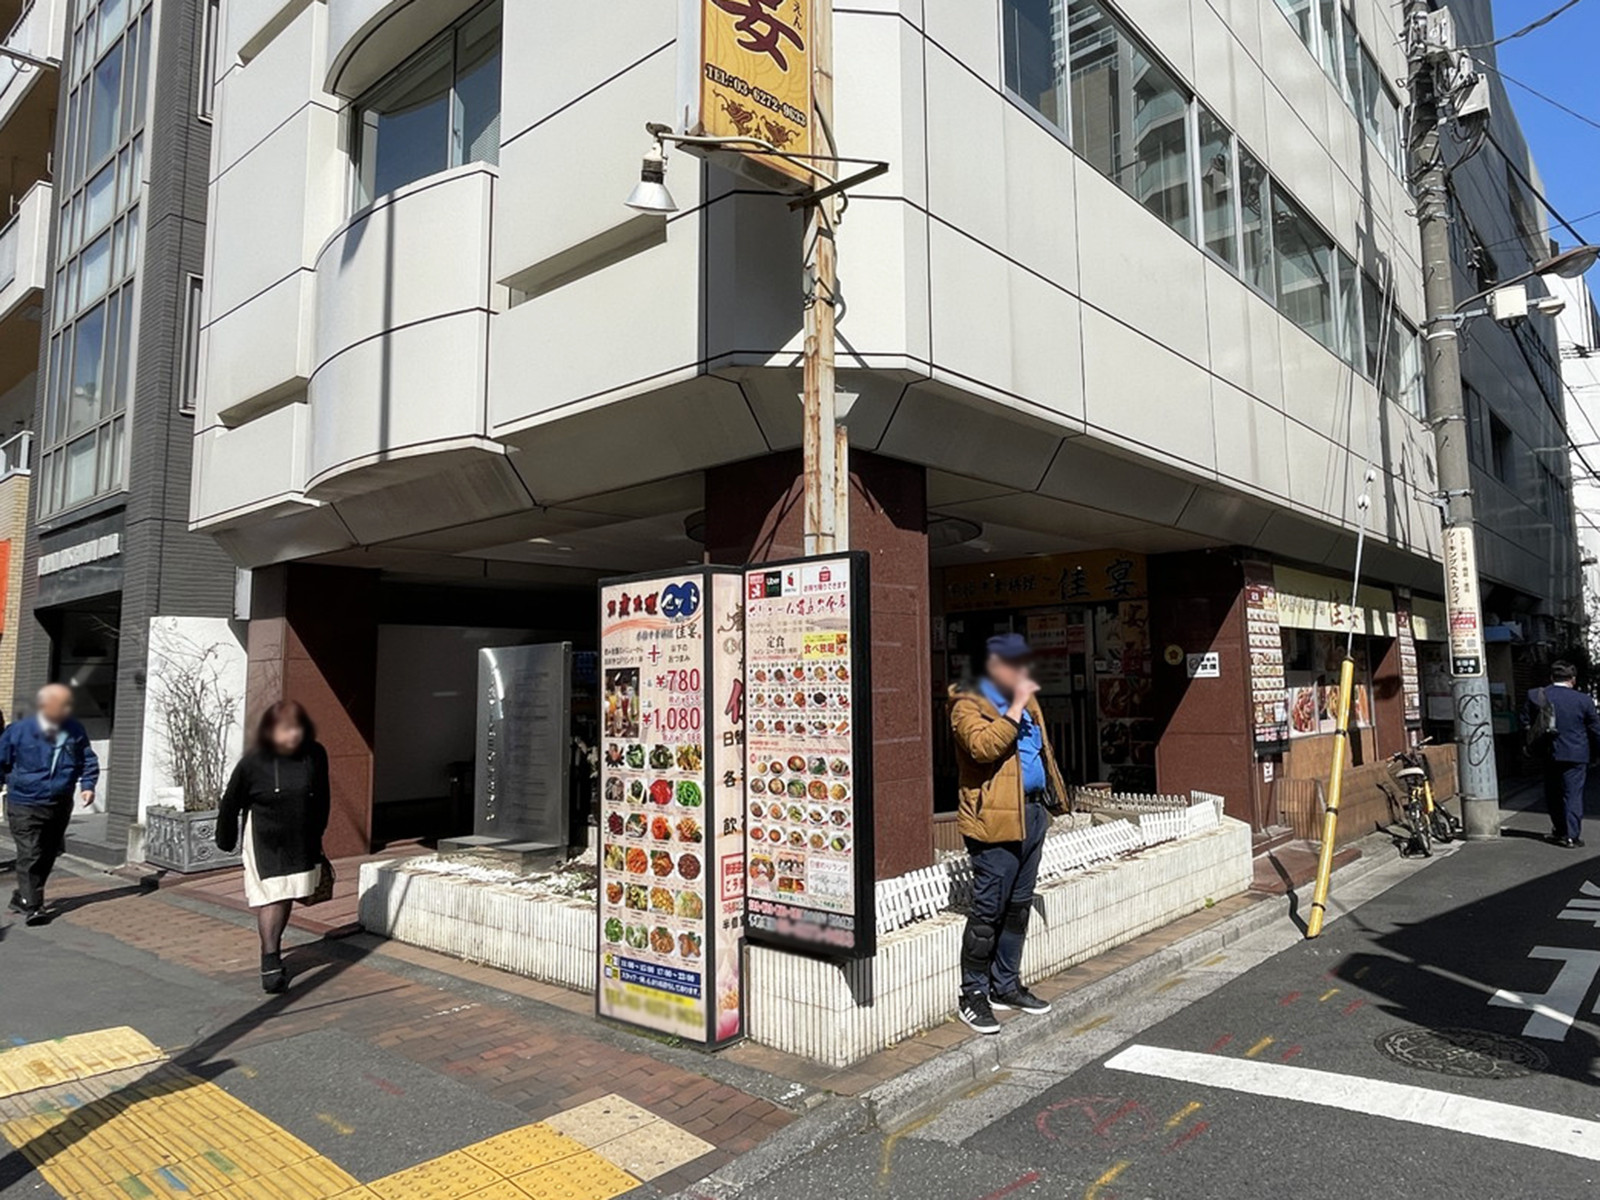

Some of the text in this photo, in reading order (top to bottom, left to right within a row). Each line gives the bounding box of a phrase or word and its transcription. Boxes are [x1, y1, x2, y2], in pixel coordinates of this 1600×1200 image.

[1058, 557, 1136, 600] 佳宴
[656, 669, 700, 691] ¥780
[643, 707, 700, 731] ¥1,080
